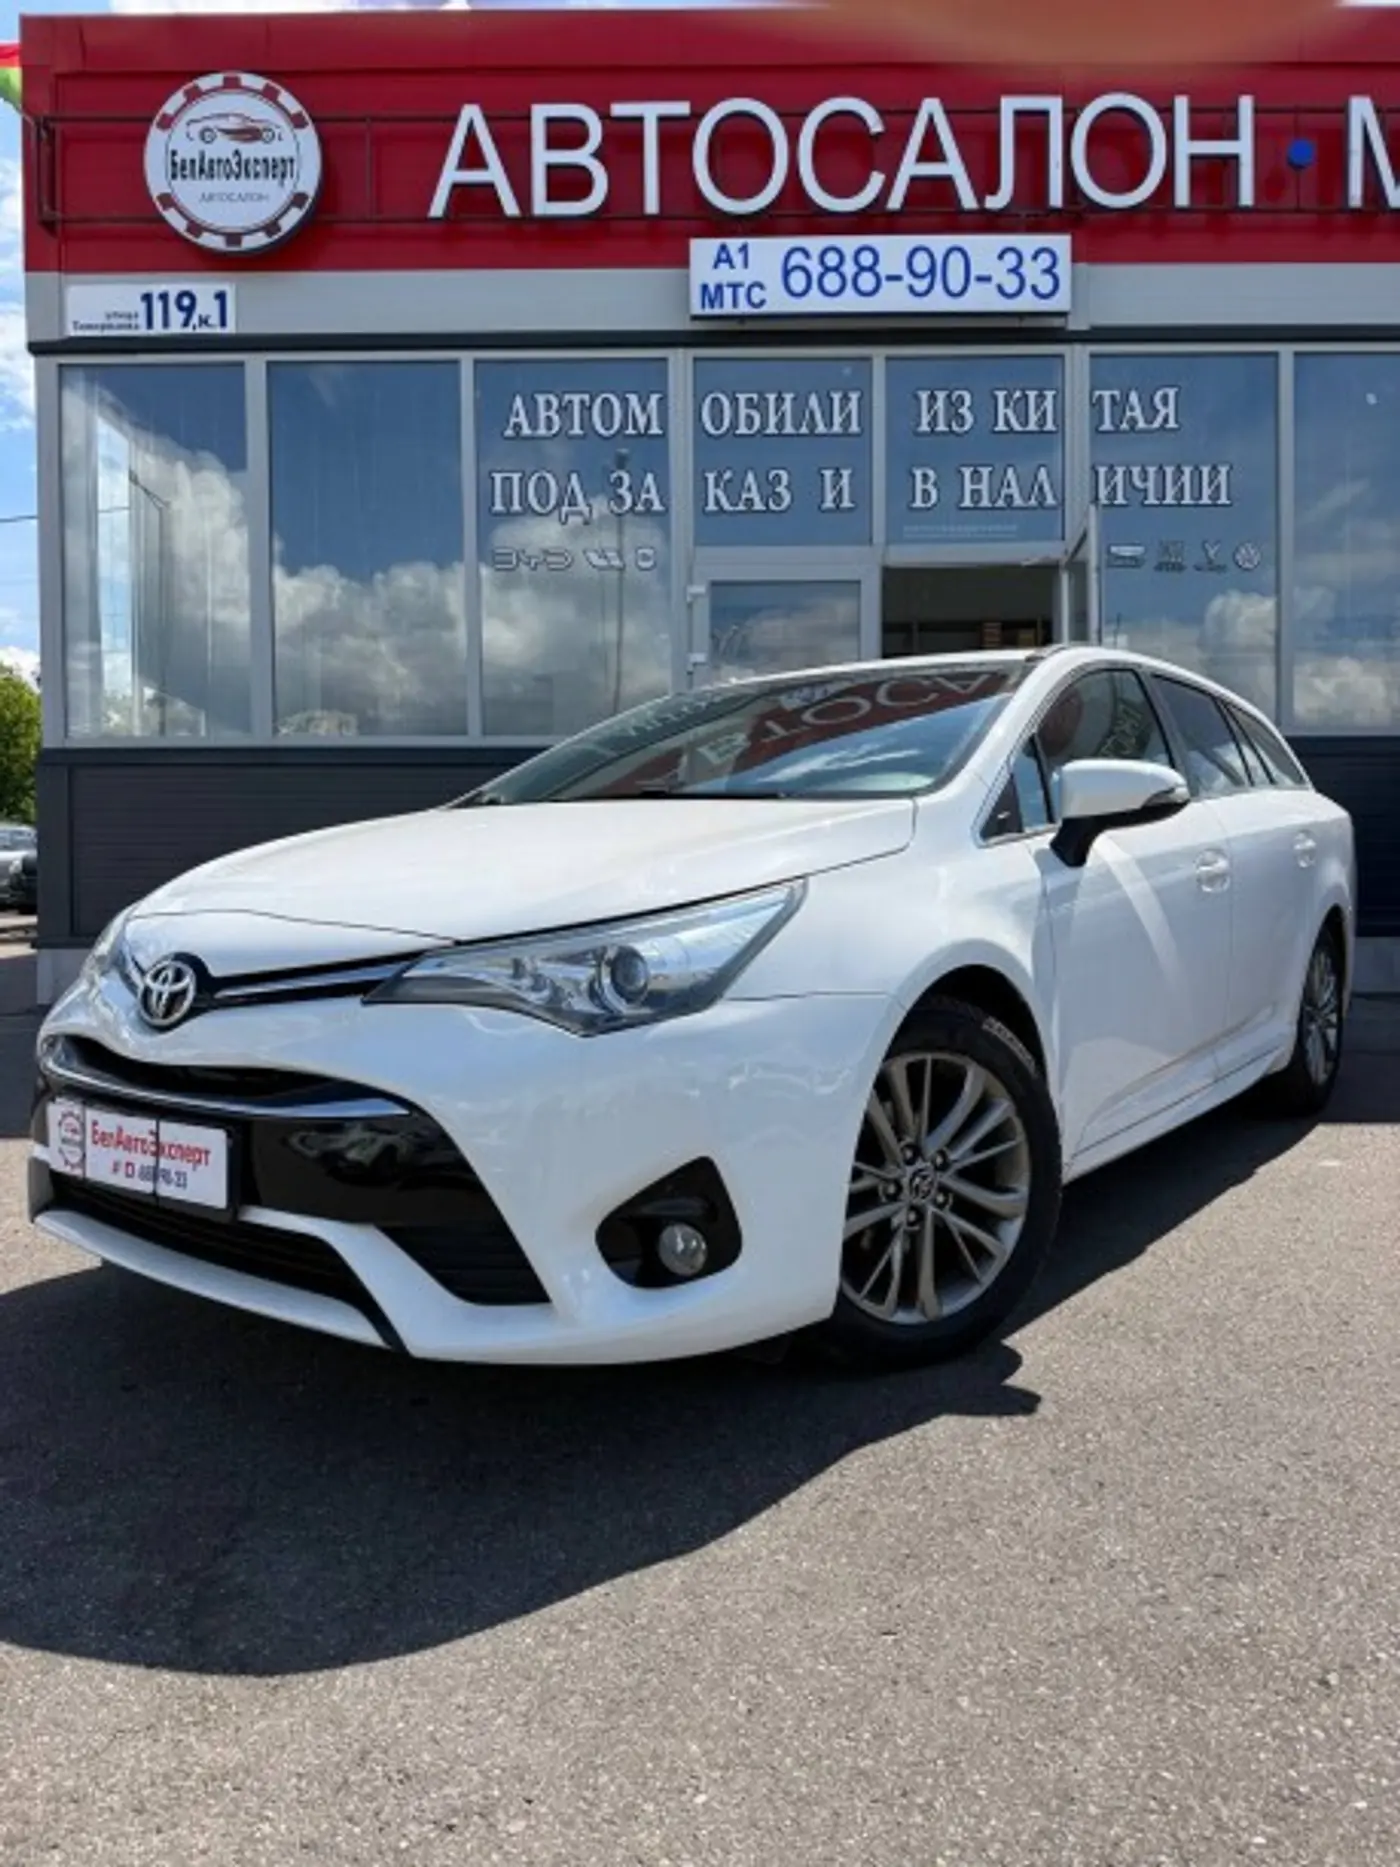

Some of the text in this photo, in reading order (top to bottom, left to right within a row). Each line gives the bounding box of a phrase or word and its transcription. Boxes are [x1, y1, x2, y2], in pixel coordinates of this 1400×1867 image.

[169, 148, 297, 188] БелАвтоЭксперт
[427, 92, 1256, 219] АВТОСАЛОН
[780, 234, 1061, 299] 688-90-33
[699, 282, 767, 309] МТС
[504, 386, 1180, 437] АВТОМ ОБИЛИ ИЗ КИ ТАЯ
[490, 464, 1232, 525] ПОД ЗА КАЗ И В НАЛ ИЧИИ
